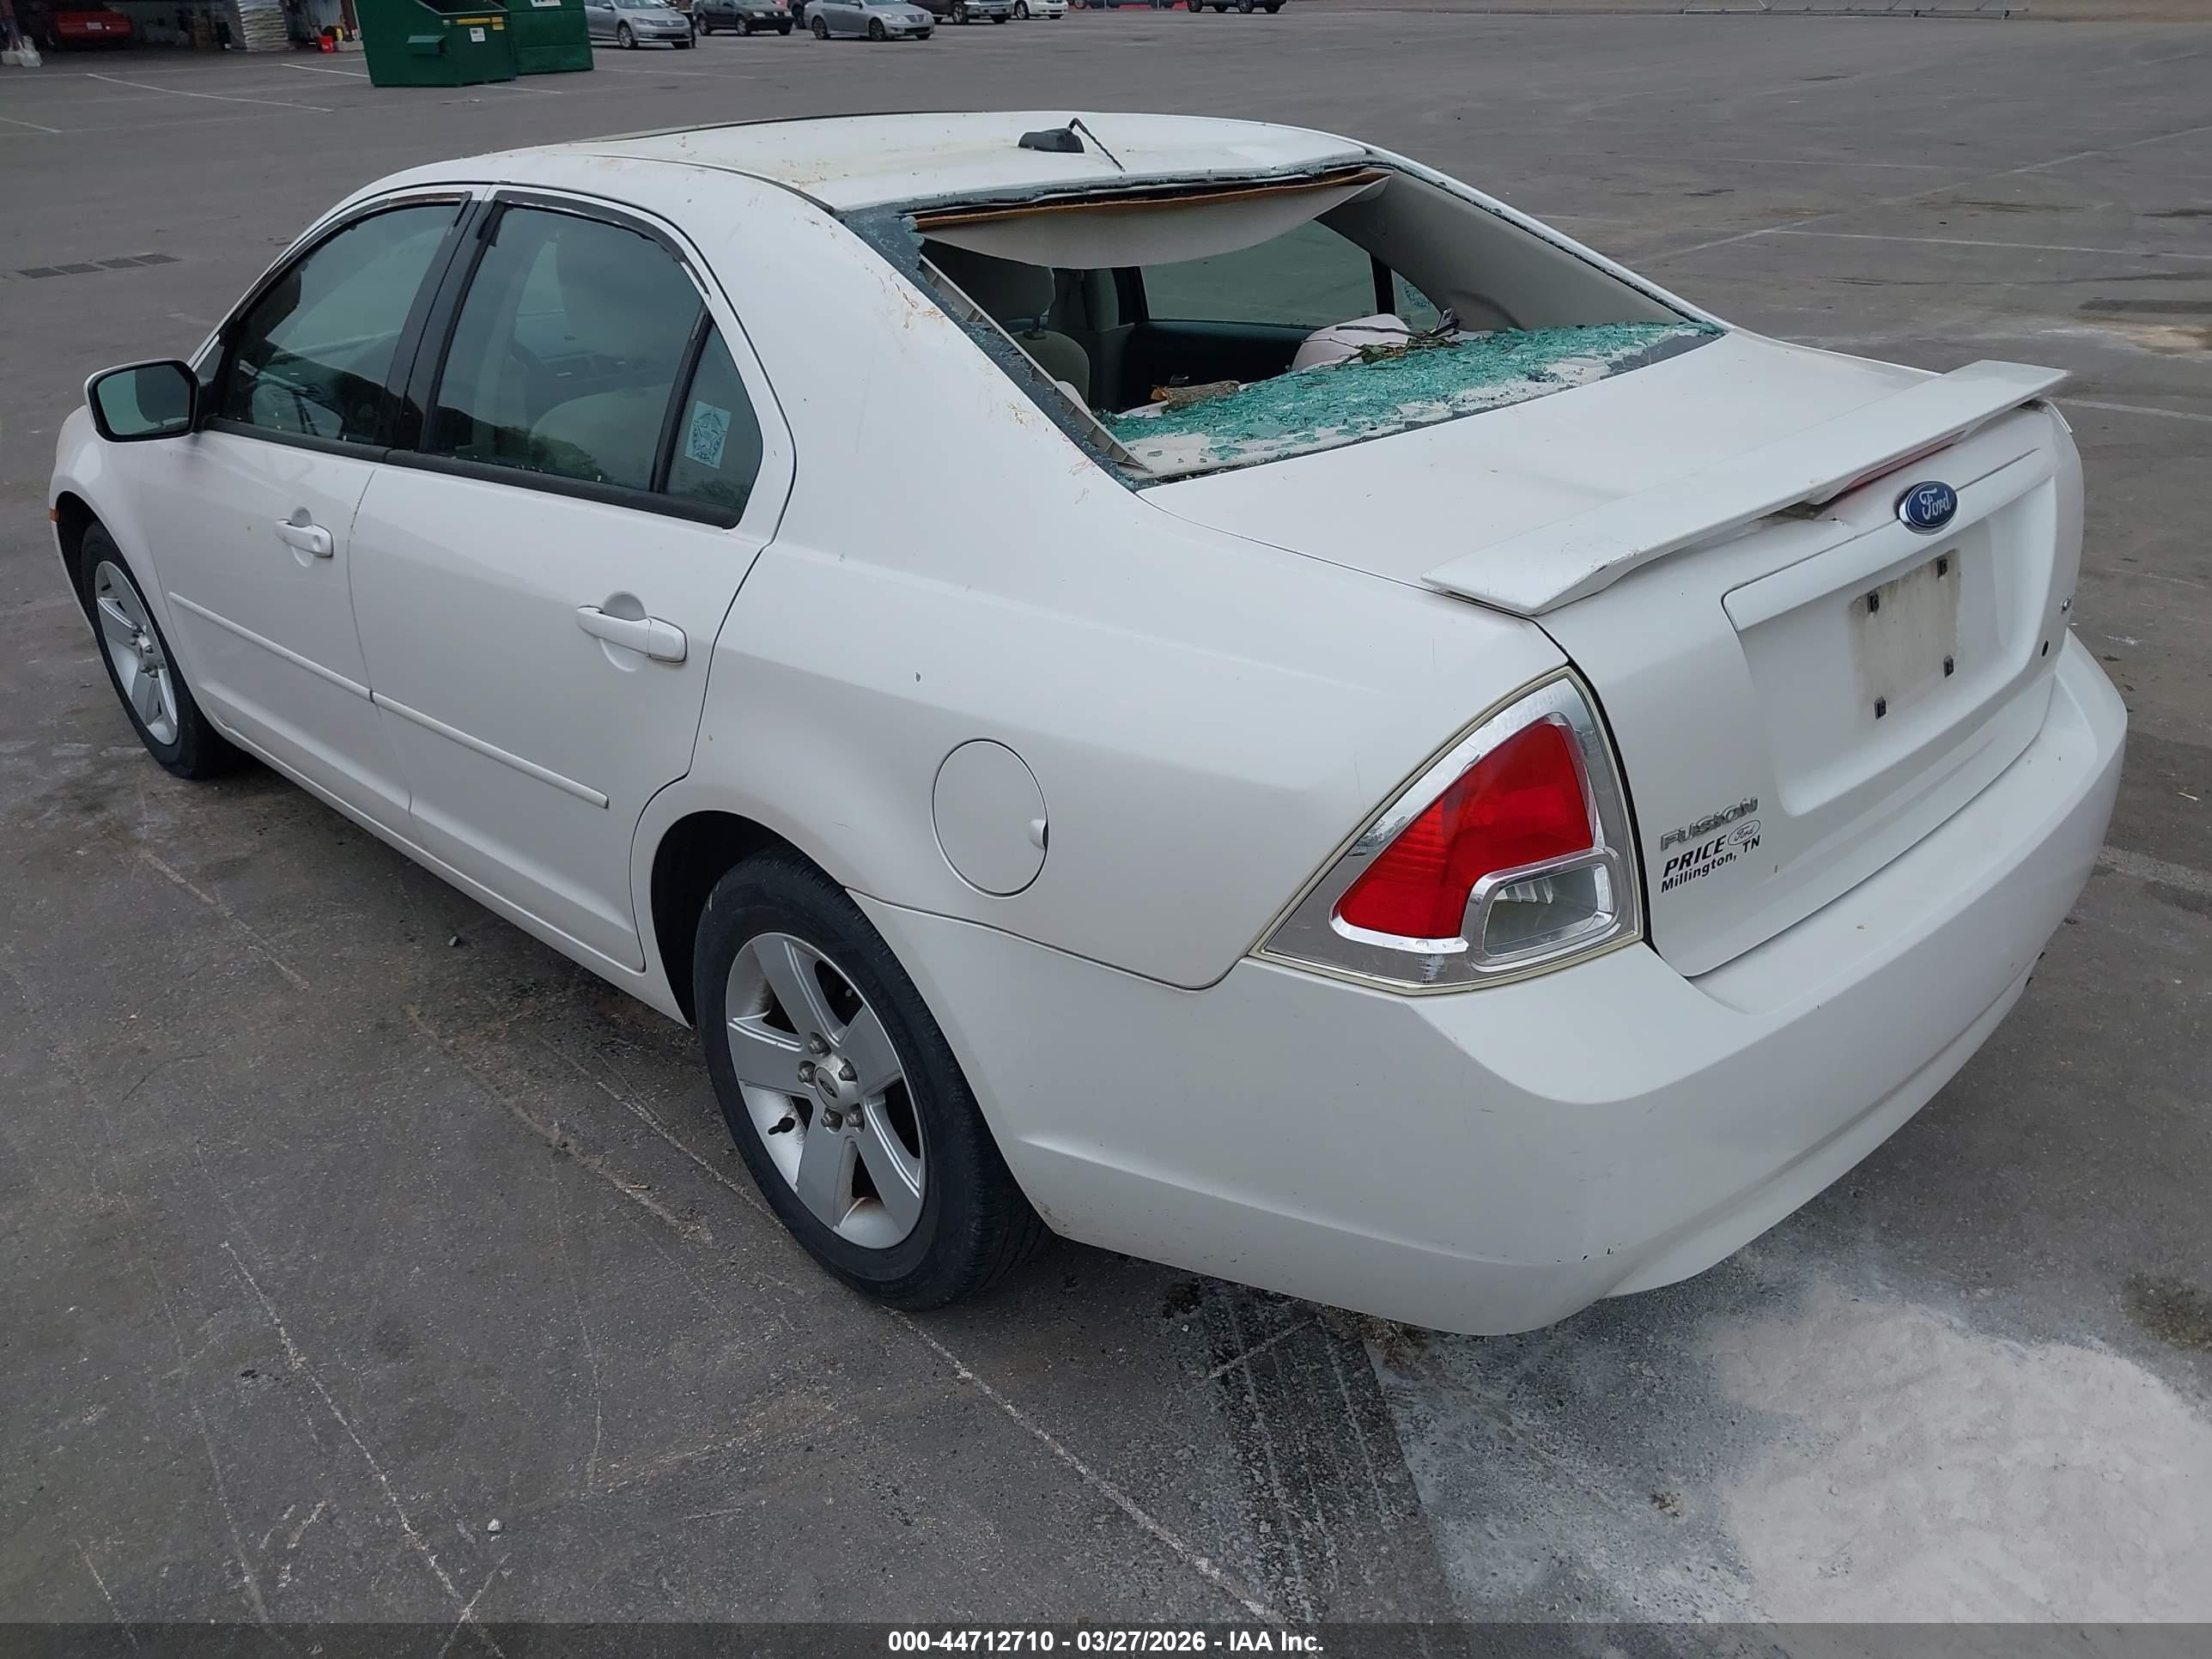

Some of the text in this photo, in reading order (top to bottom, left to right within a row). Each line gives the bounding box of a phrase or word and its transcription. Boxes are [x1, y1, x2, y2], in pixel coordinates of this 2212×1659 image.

[1918, 487, 1952, 520] Ford
[1661, 796, 1759, 852] FUSION
[1661, 835, 1761, 894] Millington, TN
[1662, 834, 1727, 878] PRICE
